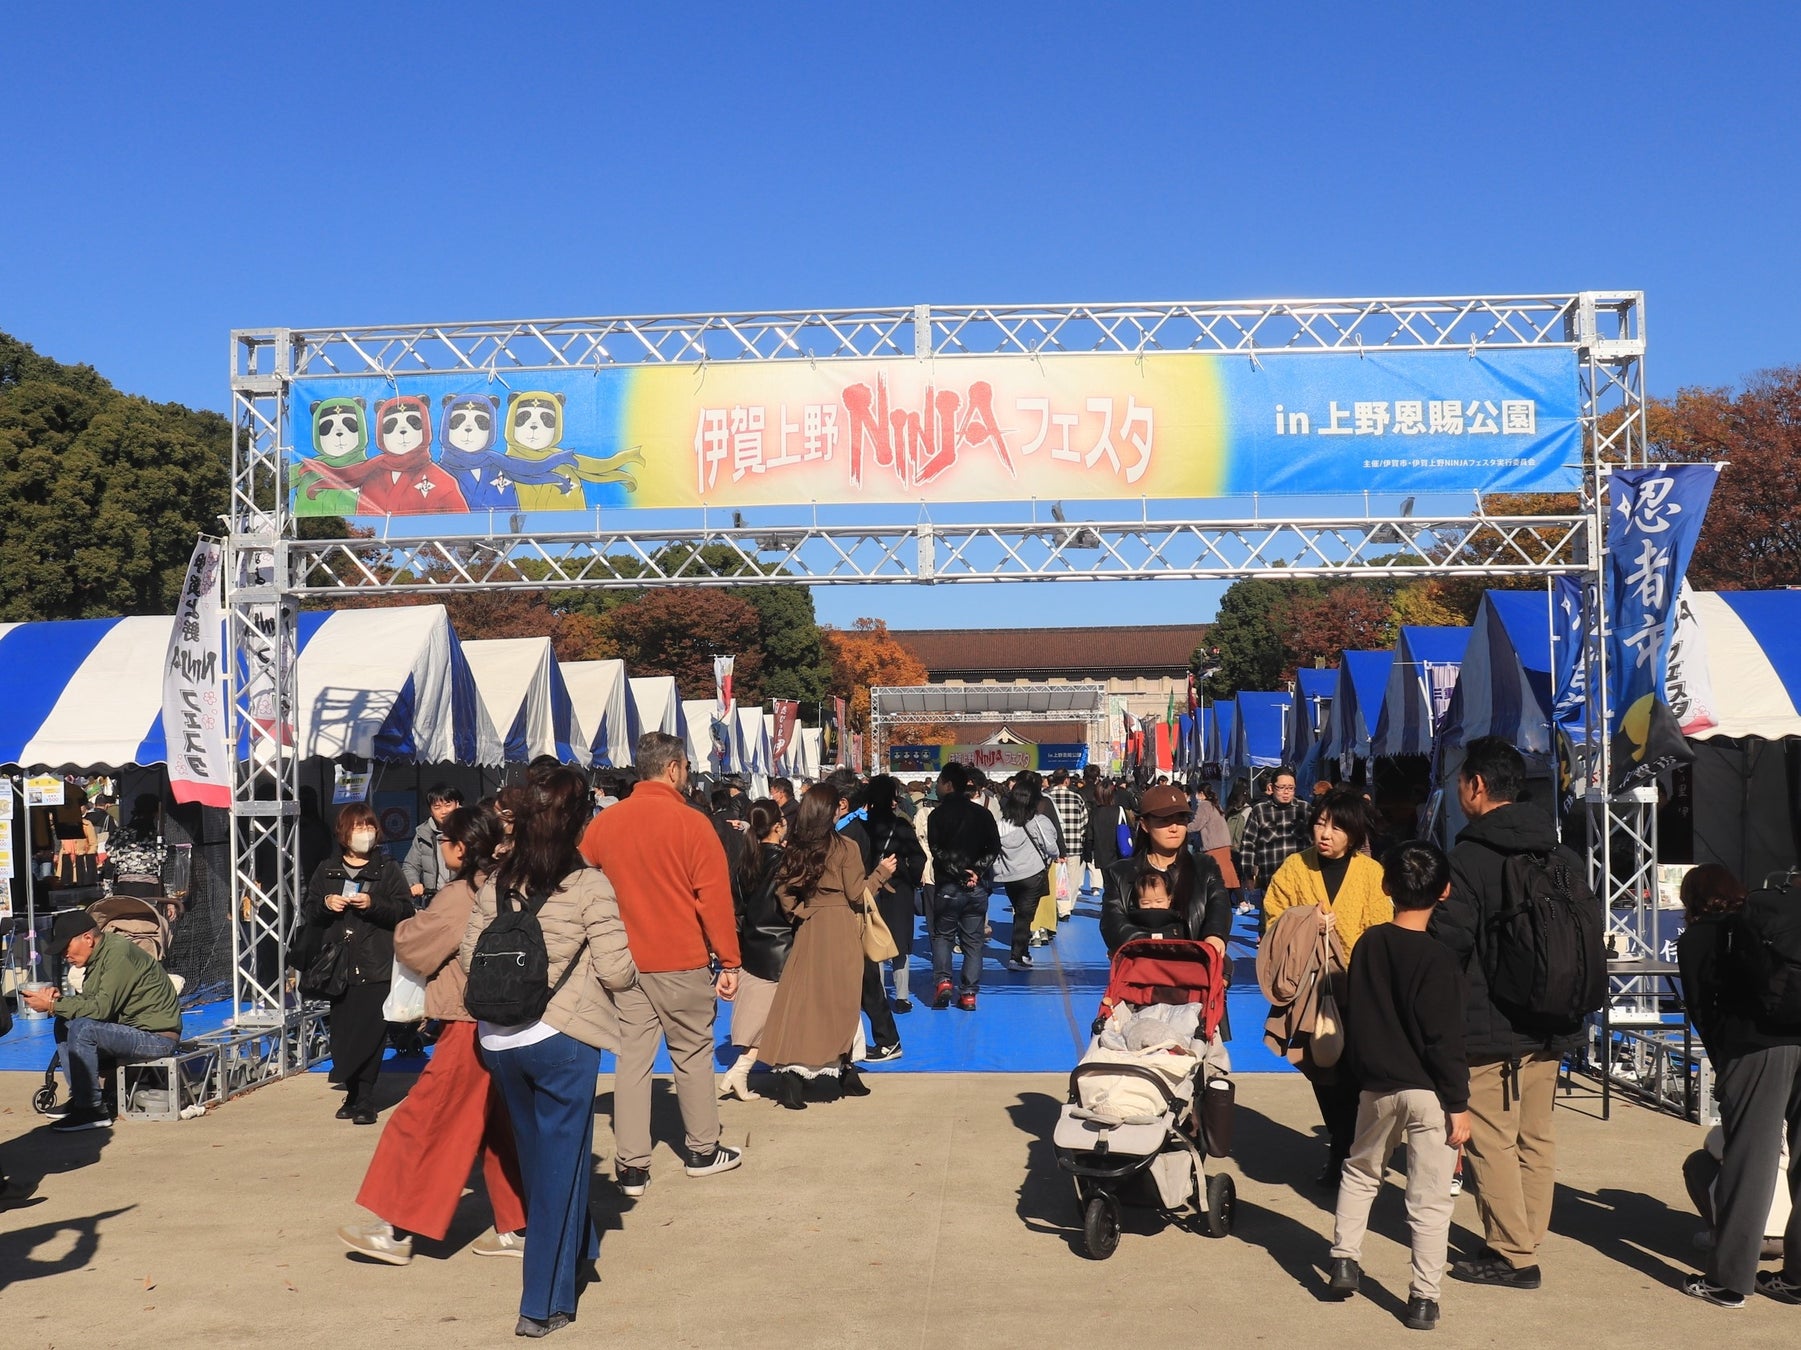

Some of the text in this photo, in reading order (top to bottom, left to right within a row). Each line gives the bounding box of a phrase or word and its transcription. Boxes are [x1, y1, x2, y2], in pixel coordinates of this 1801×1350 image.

[1275, 400, 1536, 435] in 上野恩賜公園
